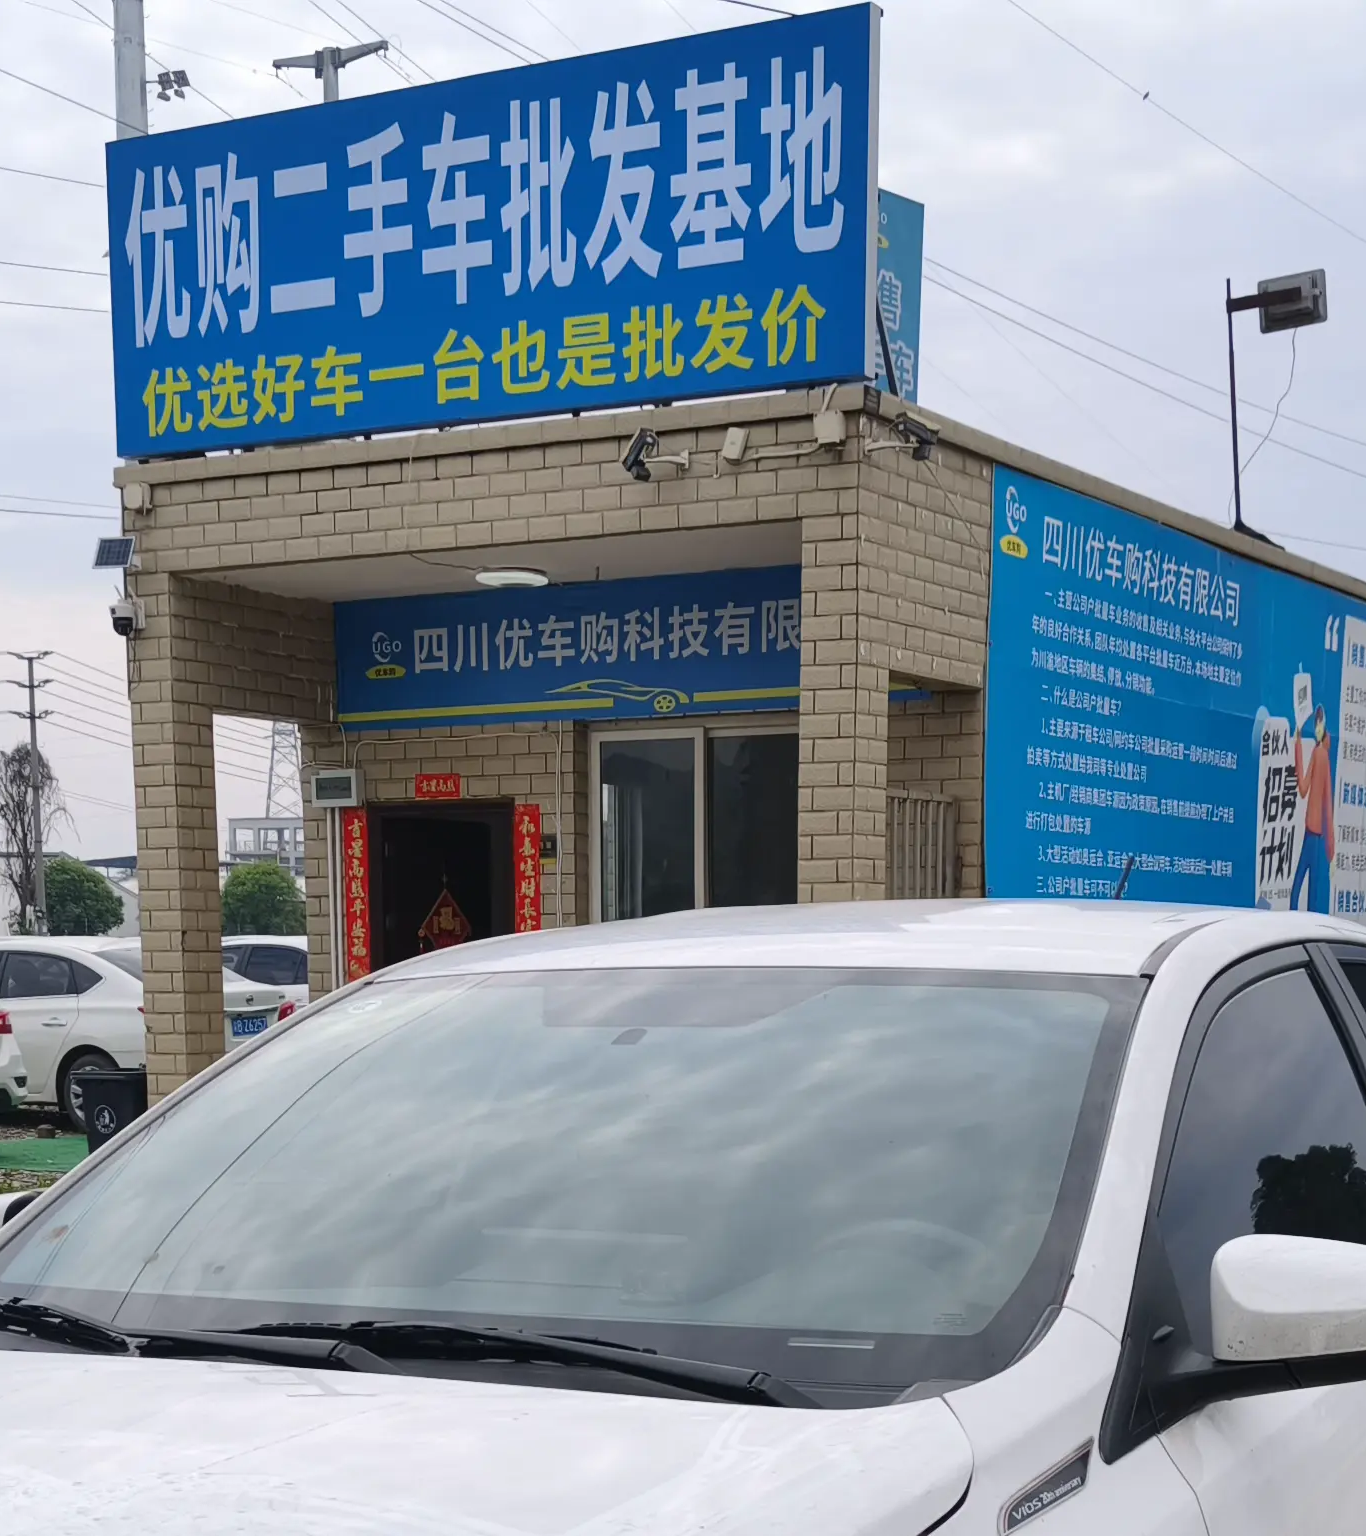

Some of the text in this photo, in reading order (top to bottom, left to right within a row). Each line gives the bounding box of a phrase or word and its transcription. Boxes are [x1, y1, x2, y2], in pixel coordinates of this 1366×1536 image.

[124, 46, 843, 348] 优购二手车批发基地
[143, 284, 826, 437] 优选好车一台也是批发价
[1042, 516, 1240, 627] 四川优车购科技有限公司
[372, 640, 402, 654] UGO
[414, 599, 800, 675] 四川优车购科技有限
[1262, 729, 1289, 756] 合伙人
[1259, 825, 1295, 887] 计划
[1012, 1497, 1042, 1520] VIOS
